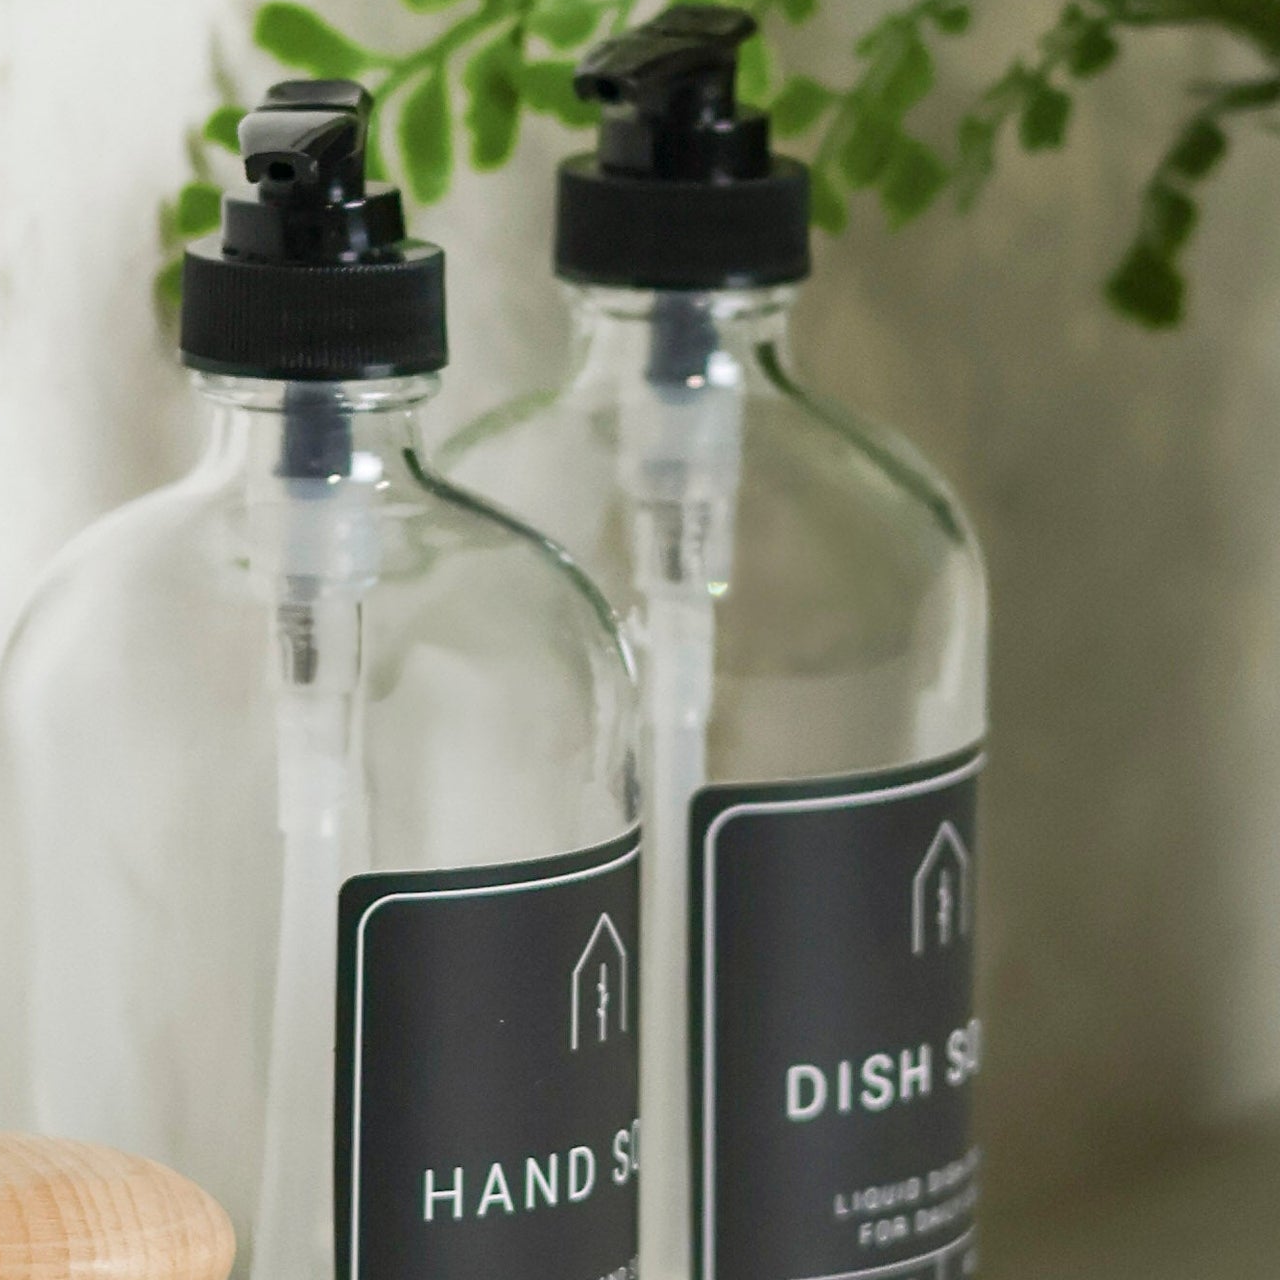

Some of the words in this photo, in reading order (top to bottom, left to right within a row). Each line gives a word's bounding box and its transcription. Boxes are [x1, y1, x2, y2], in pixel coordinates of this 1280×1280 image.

[786, 1043, 932, 1121] DISH
[423, 1145, 596, 1221] HAND
[833, 1176, 921, 1215] LIQUID
[858, 1216, 909, 1246] FOR
